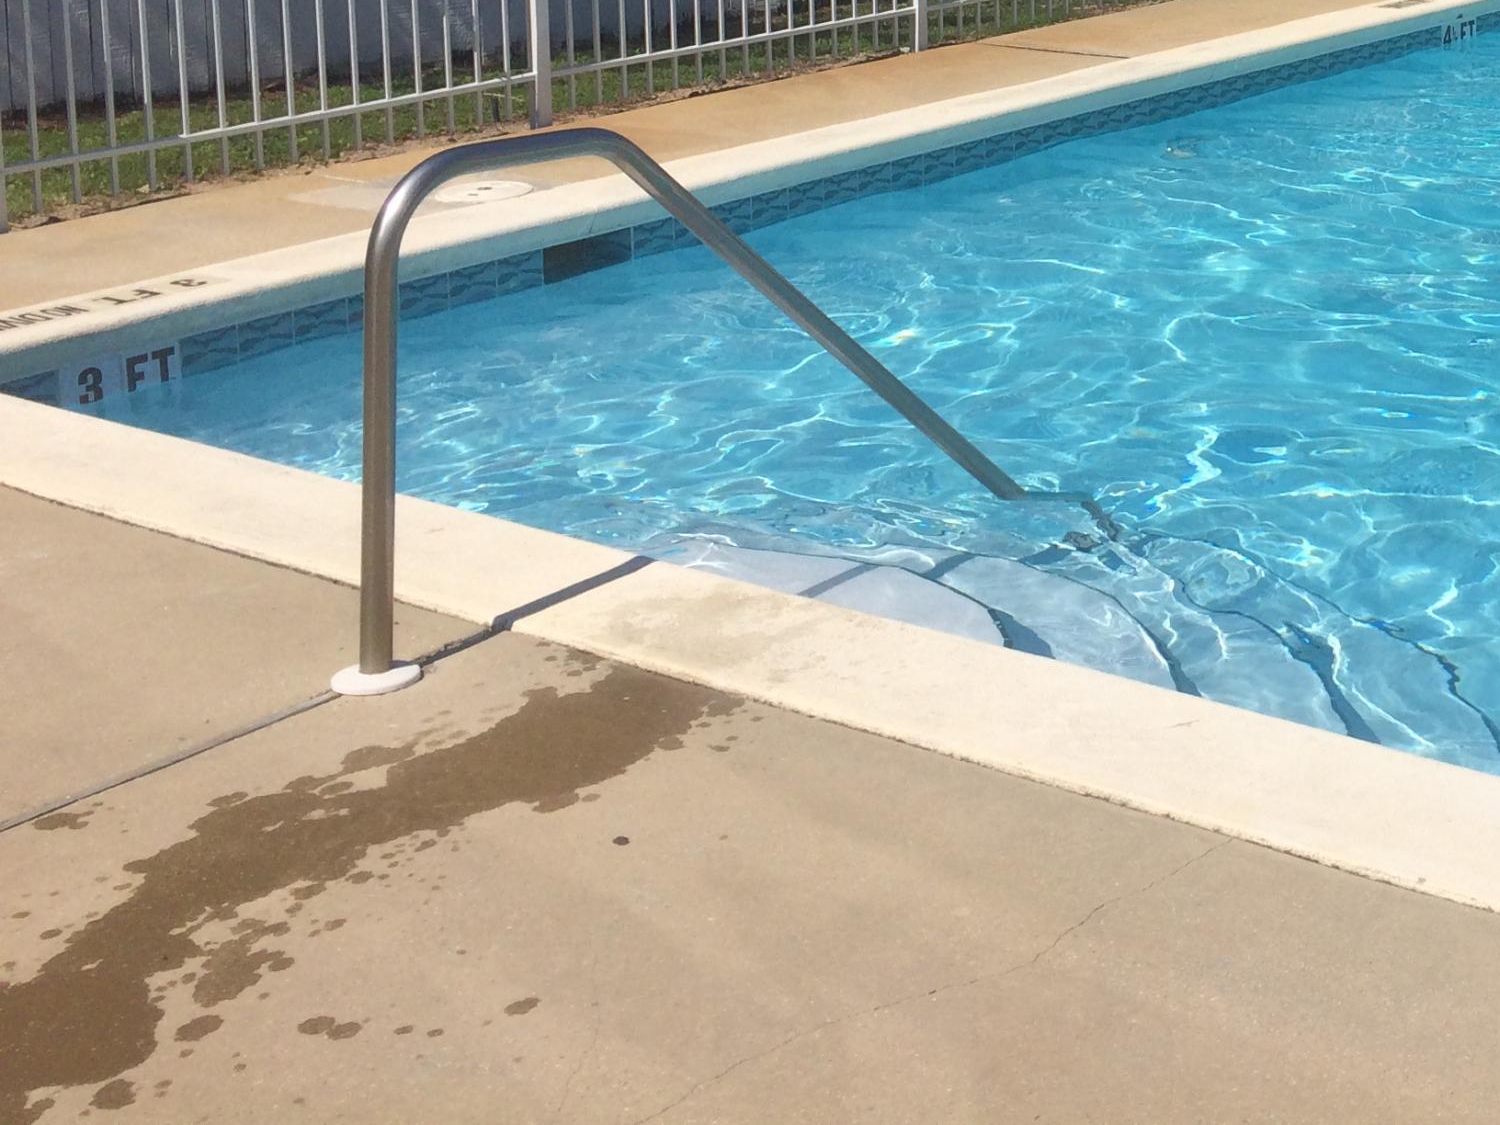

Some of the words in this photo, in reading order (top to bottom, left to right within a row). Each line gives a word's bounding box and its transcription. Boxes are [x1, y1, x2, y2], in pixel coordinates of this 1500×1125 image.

[1443, 24, 1457, 44] 4
[1460, 20, 1475, 41] FT
[77, 366, 104, 404] 3
[126, 346, 175, 392] FT
